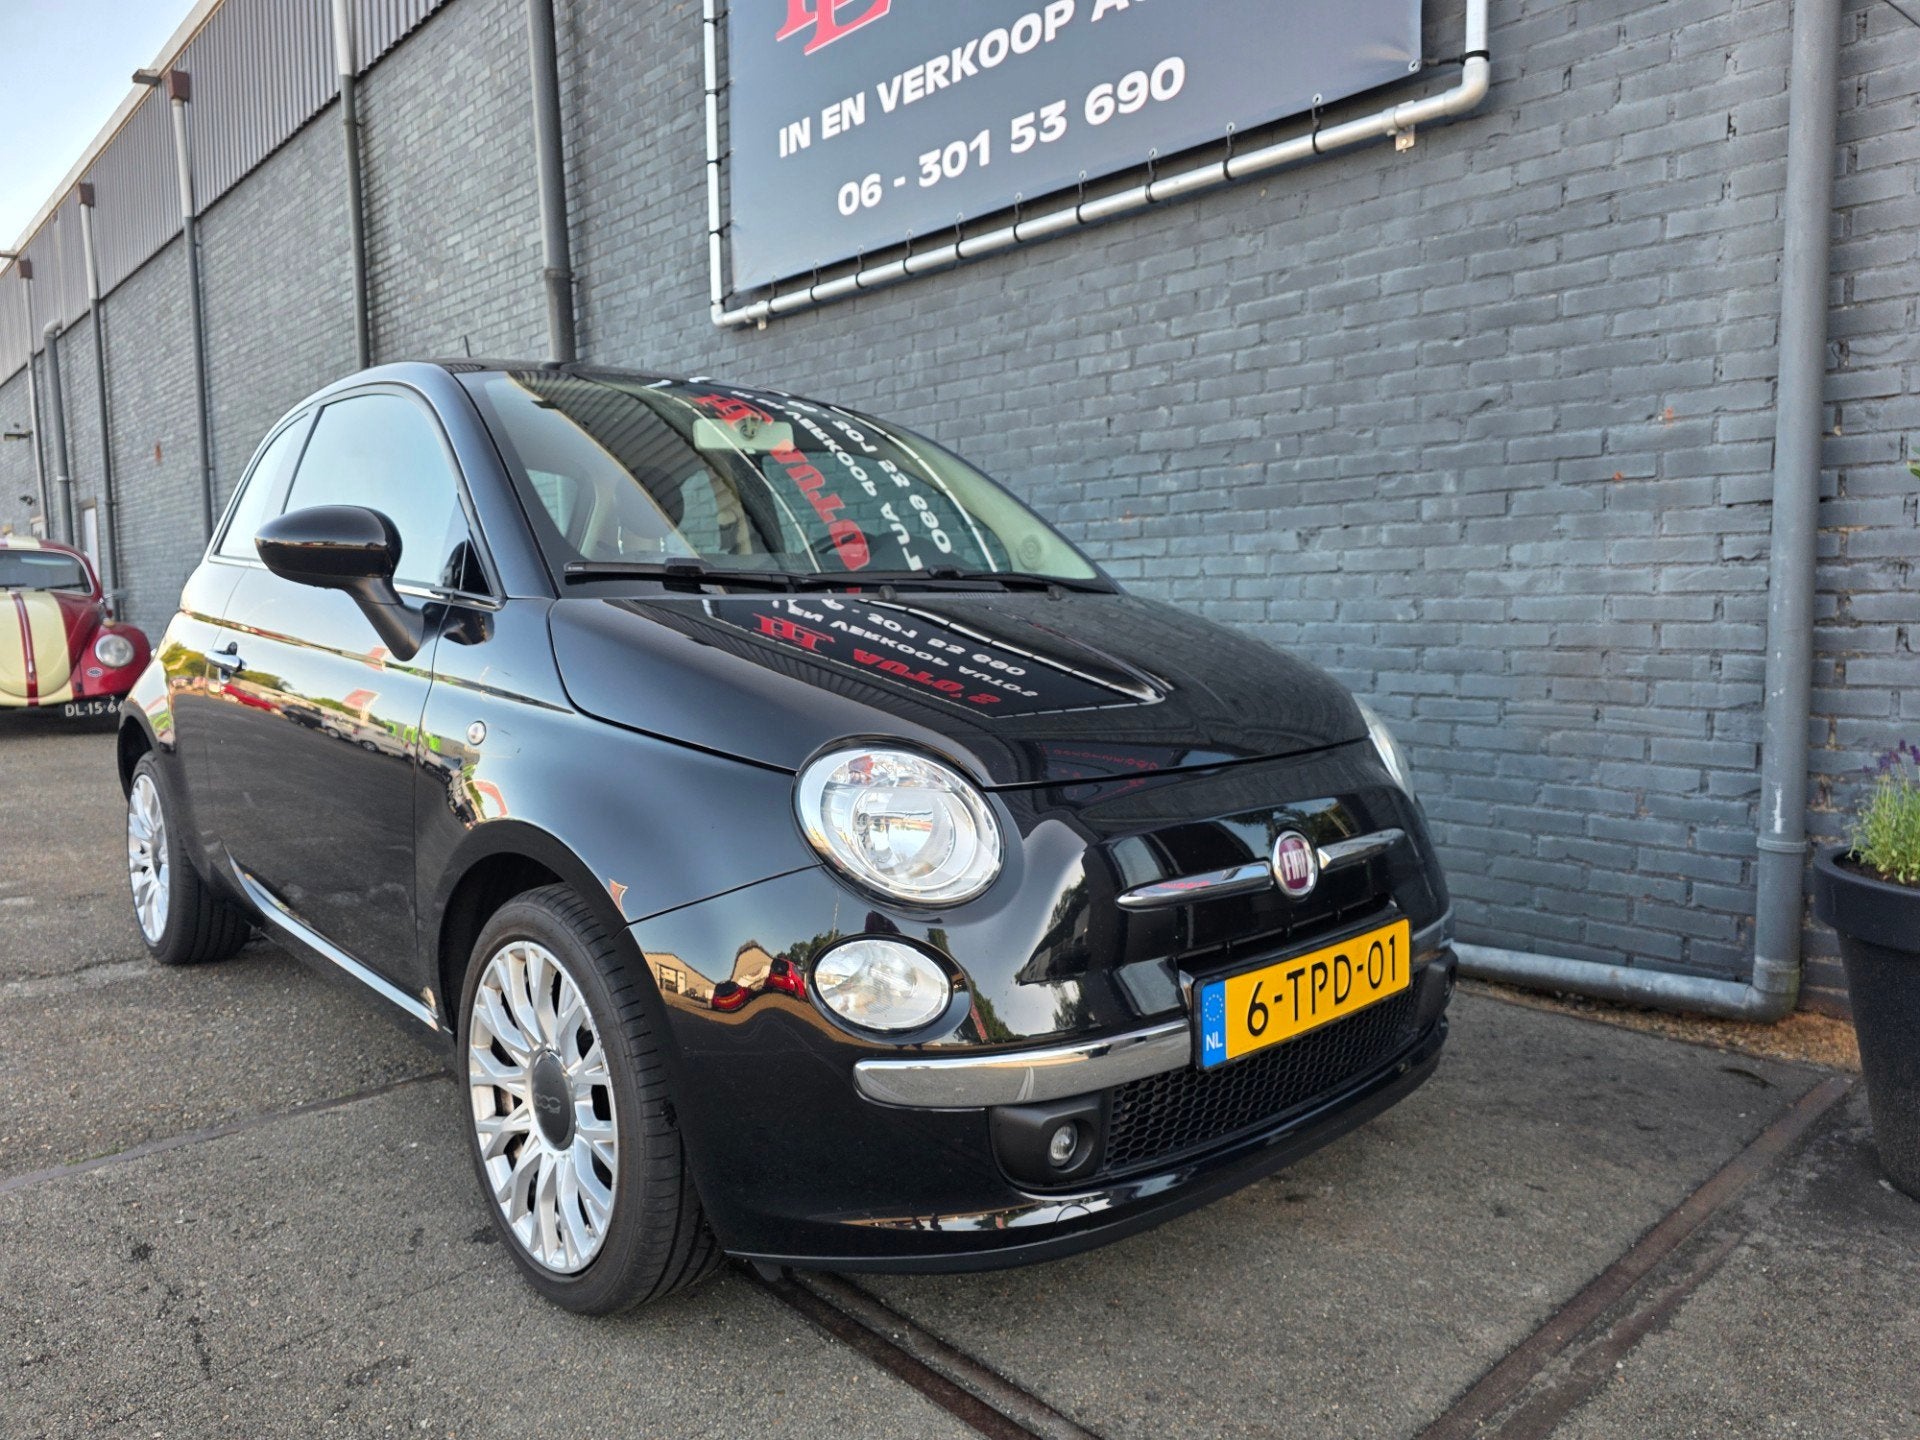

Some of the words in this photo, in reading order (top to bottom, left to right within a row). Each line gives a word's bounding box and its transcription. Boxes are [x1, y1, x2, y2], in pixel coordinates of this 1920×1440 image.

[779, 117, 811, 158] IN
[821, 91, 865, 141] EN
[876, 0, 1075, 114] VERKOOP
[837, 173, 882, 216] 06
[919, 129, 991, 187] 301
[1010, 100, 1067, 153] 53
[1084, 57, 1185, 126] 690
[1282, 849, 1307, 881] FIAT
[1247, 935, 1396, 1037] 6-TPD-01
[1205, 1031, 1223, 1051] NL
